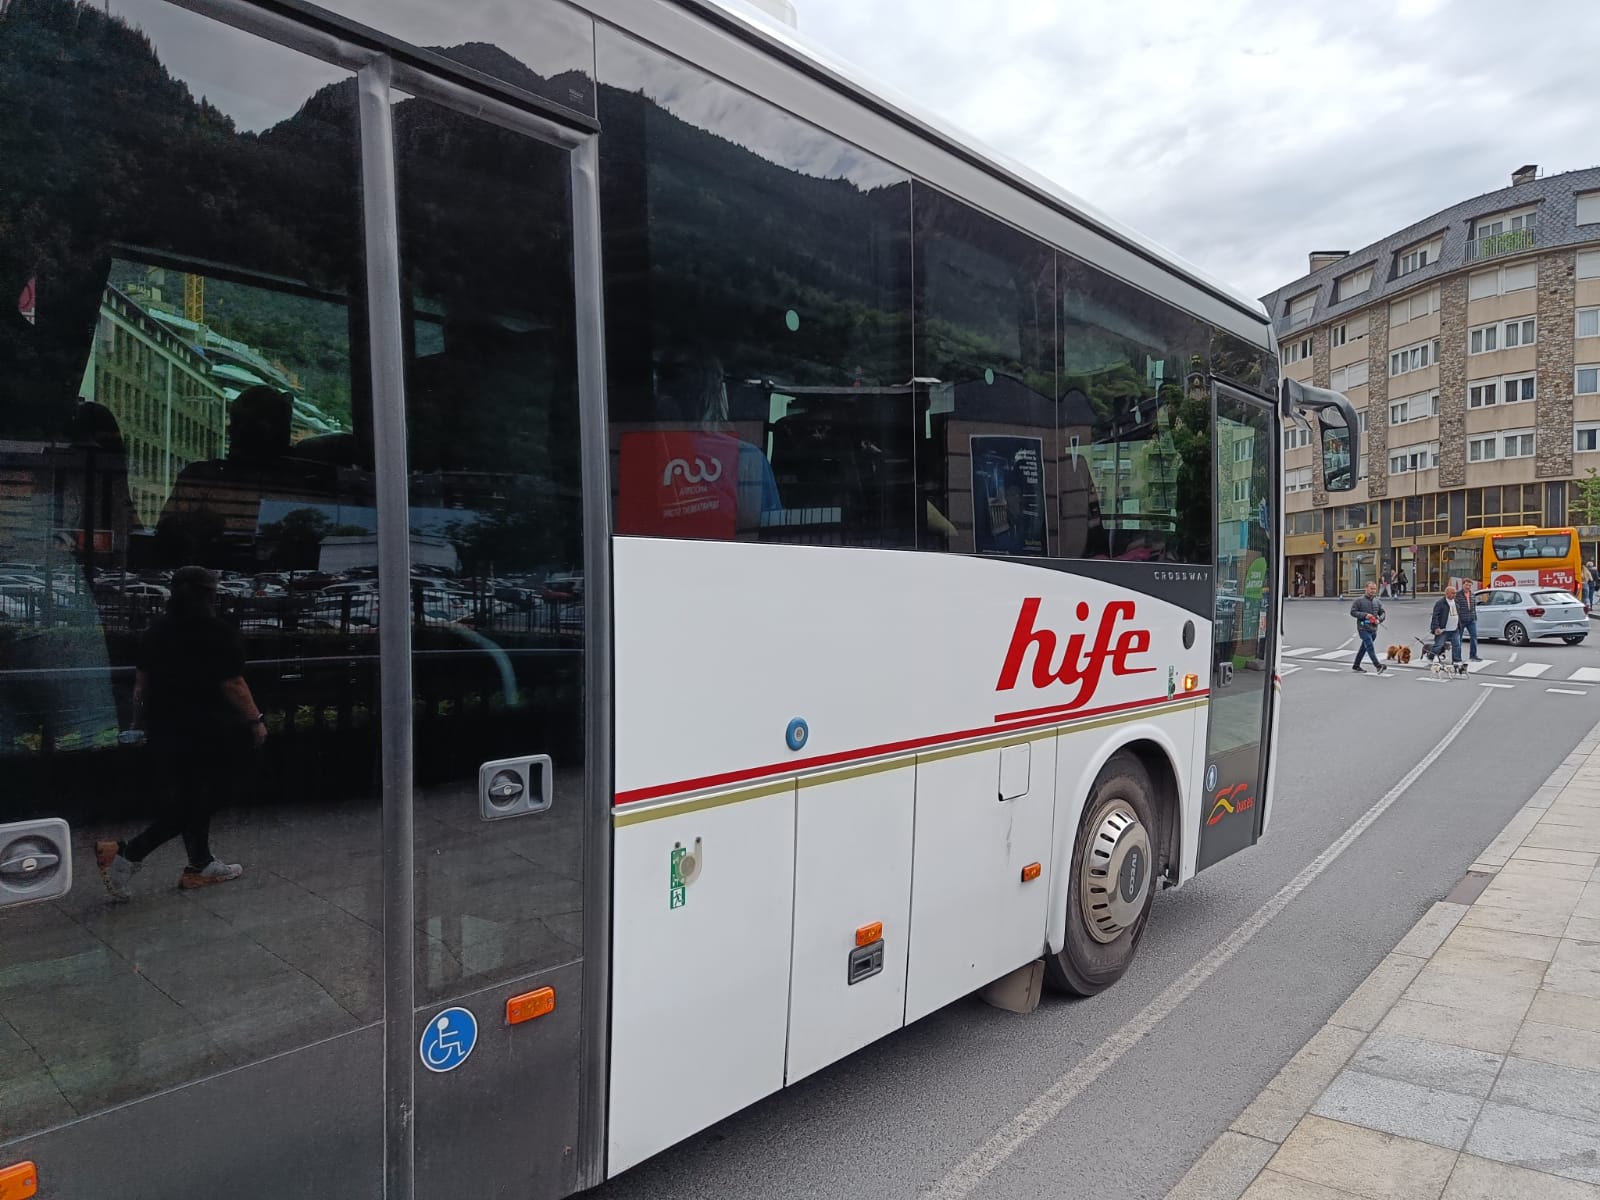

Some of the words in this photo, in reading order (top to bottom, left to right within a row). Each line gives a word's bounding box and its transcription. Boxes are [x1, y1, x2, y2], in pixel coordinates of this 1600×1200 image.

[1153, 571, 1208, 582] CROSSWAY
[1558, 576, 1573, 584] TU
[995, 597, 1158, 722] hife
[1128, 853, 1138, 896] IVECO
